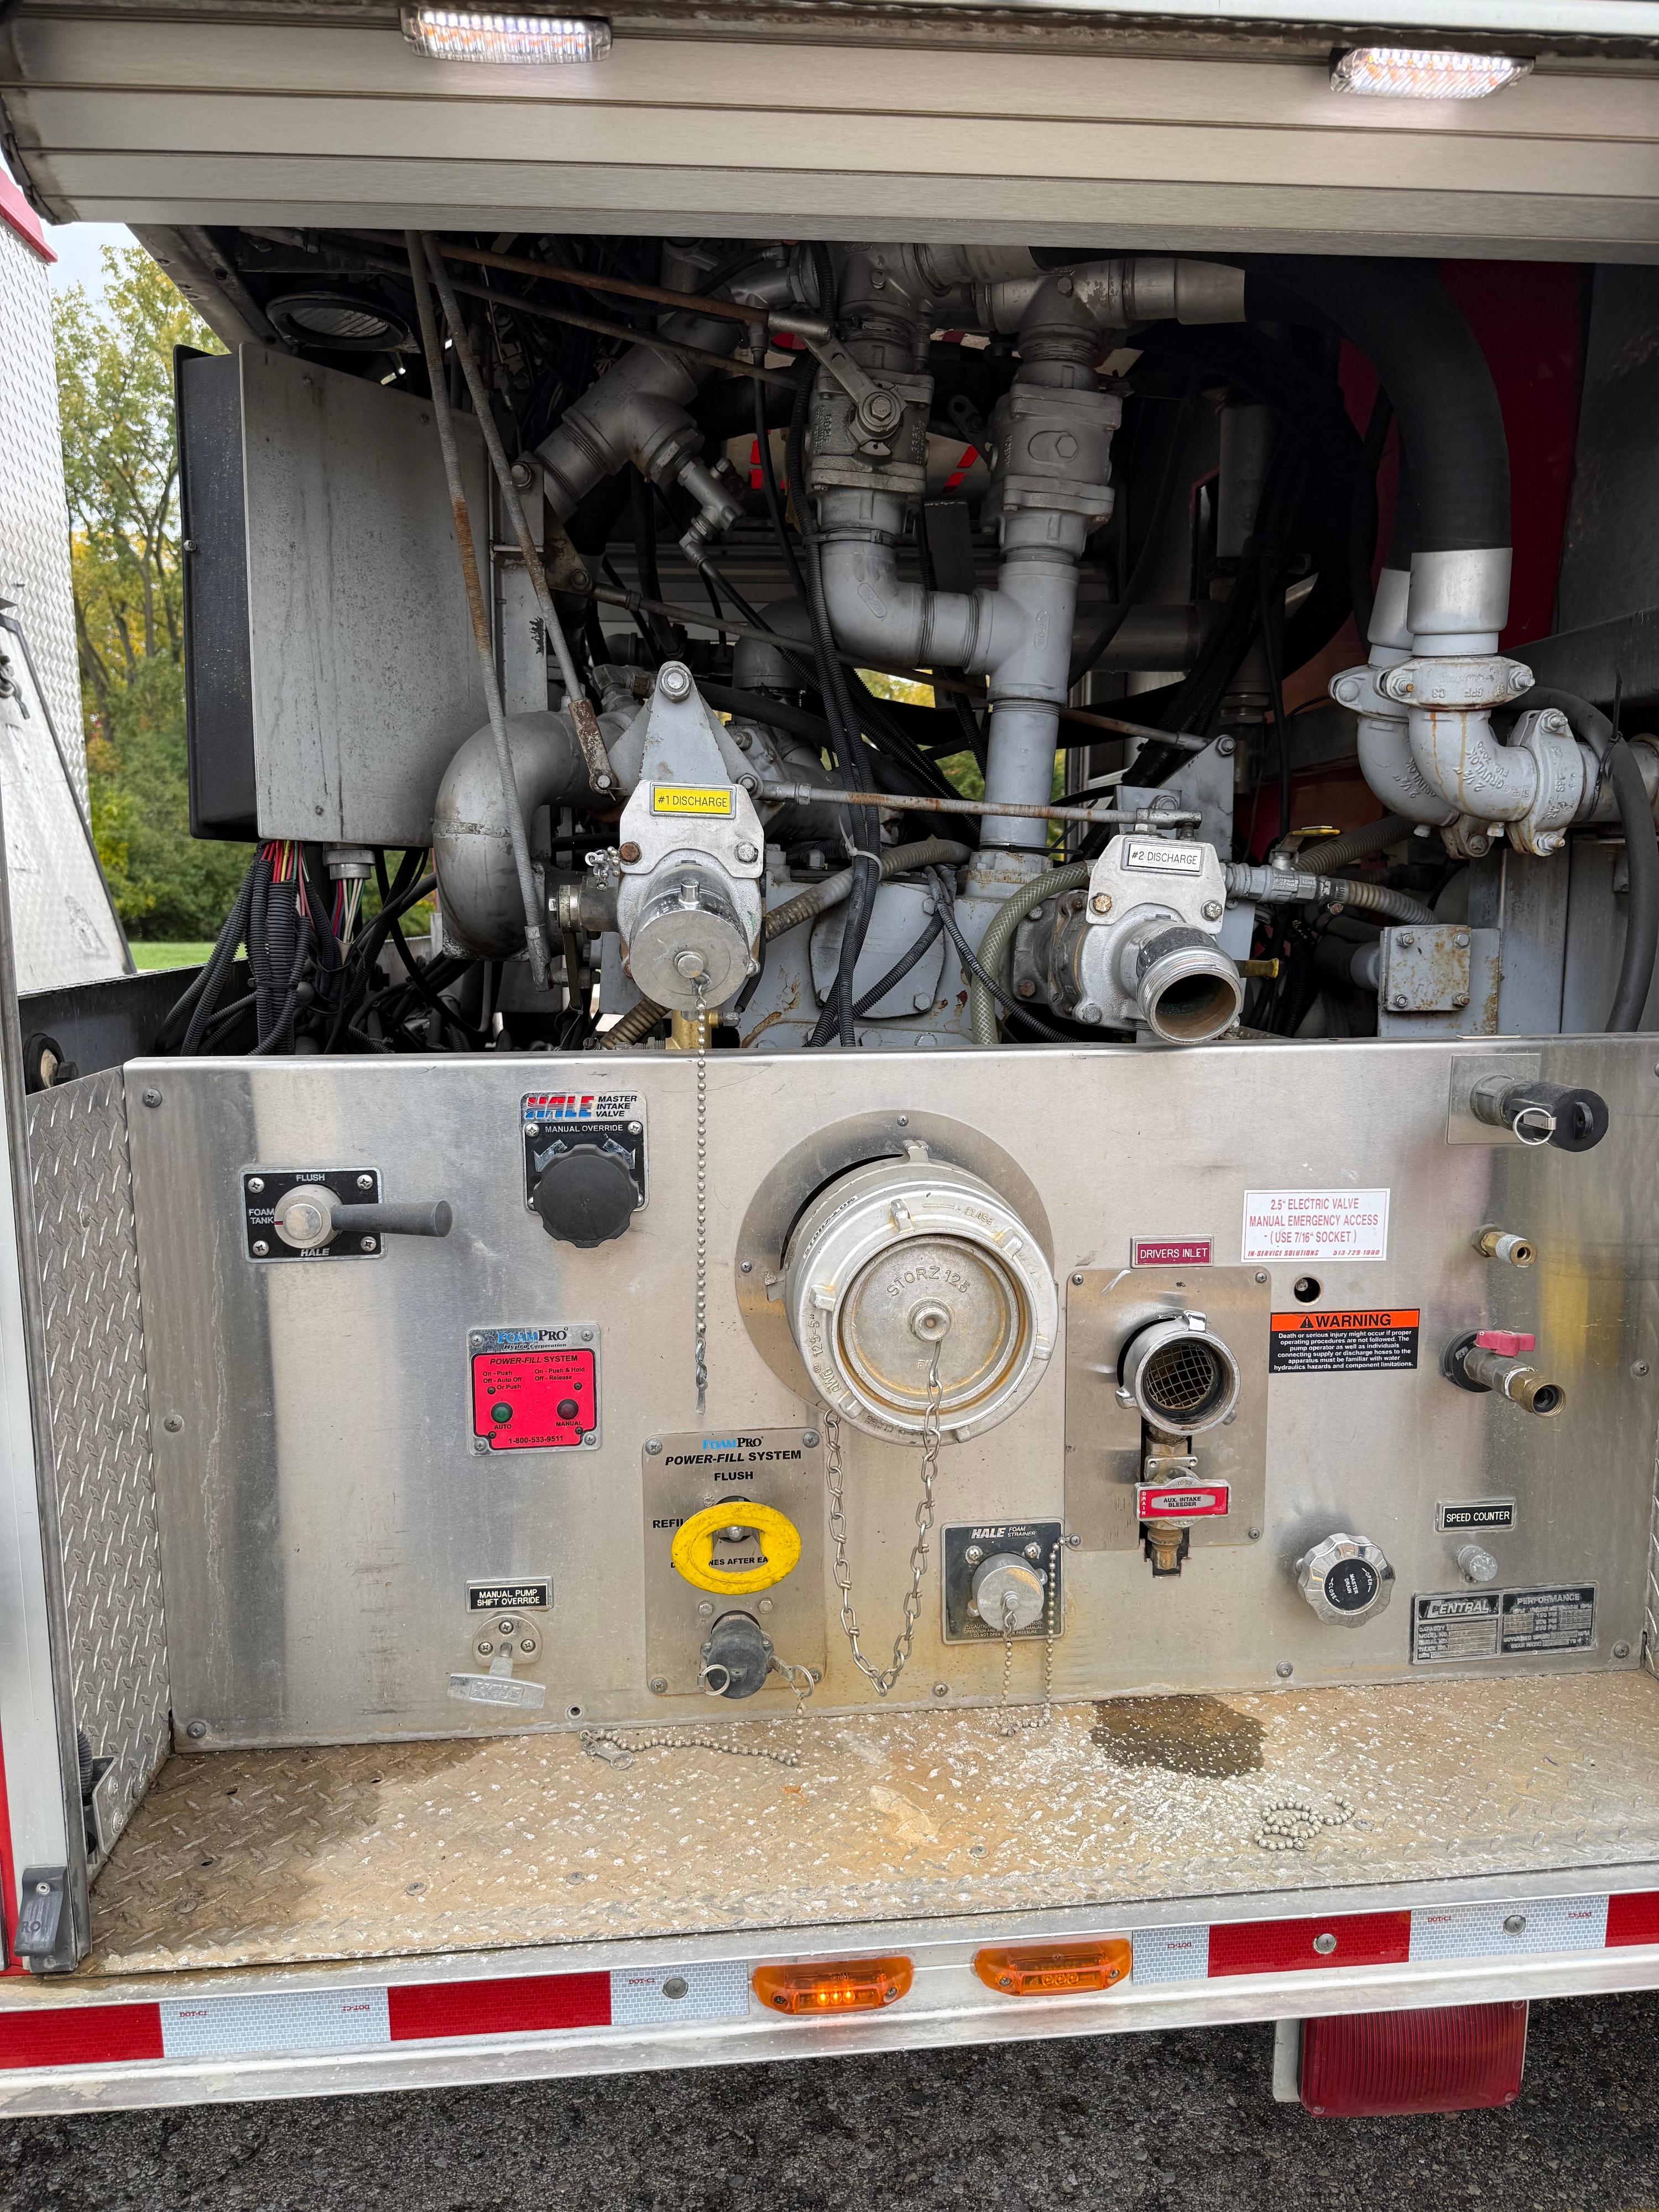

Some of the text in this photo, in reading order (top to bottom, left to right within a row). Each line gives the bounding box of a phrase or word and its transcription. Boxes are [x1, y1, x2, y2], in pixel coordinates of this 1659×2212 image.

[658, 795, 728, 807] #1 DISCHARGE
[1131, 851, 1198, 865] #2 DISCHARGE
[525, 1095, 595, 1119] HALE
[1287, 1197, 1329, 1211] ELECTRIC
[1332, 1198, 1359, 1210] VALVE
[249, 1208, 274, 1217] FOAM
[1249, 1214, 1379, 1227] MANUAL EMERGENCY ACCESS
[1275, 1232, 1292, 1244] USE
[1315, 1230, 1352, 1243] SOCKET
[300, 1248, 331, 1257] HALE
[1140, 1248, 1208, 1259] DRIVERS INLET
[886, 1266, 971, 1297] STORZ 125
[1315, 1313, 1391, 1328] WARNING
[489, 1355, 578, 1366] POWER-FILL SYSTEM
[508, 1435, 564, 1444] 1-800-533-9511
[665, 1449, 801, 1466] POWER-FILL SYSTEM
[714, 1471, 754, 1481] FLUSH
[1446, 1511, 1510, 1524] SPEED COUNTER
[971, 1527, 1006, 1539] HALE
[1349, 1573, 1359, 1595] MASTER
[1365, 1571, 1373, 1586] OPEN
[1328, 1582, 1338, 1600] CLOSE
[1344, 1578, 1353, 1594] DRAIN
[477, 1596, 540, 1606] SHIFT OVERRIDE
[479, 1590, 513, 1599] MANUAL
[1517, 1593, 1580, 1605] PERFORMANCE
[1427, 1599, 1490, 1619] CENTRAL
